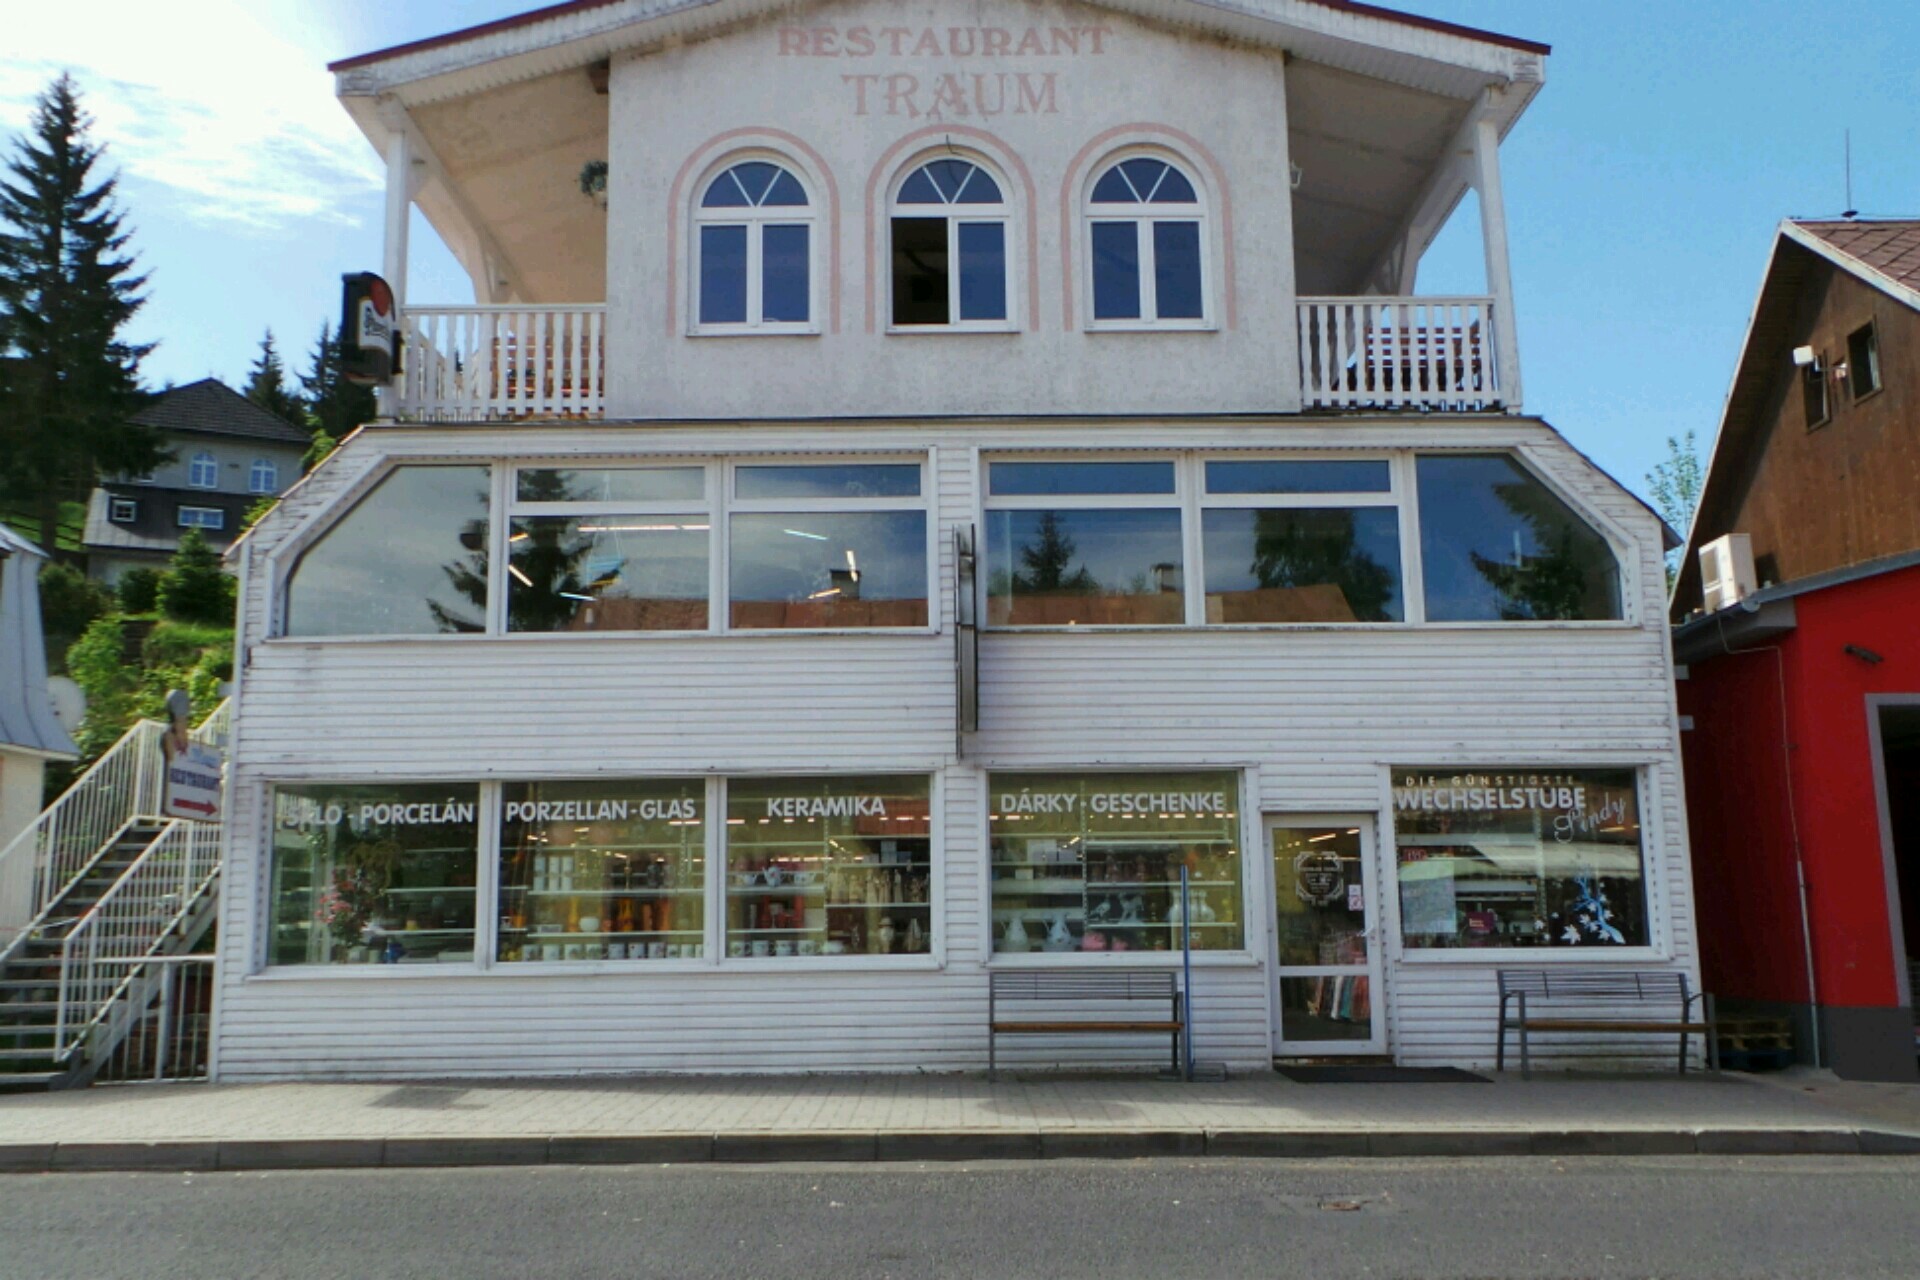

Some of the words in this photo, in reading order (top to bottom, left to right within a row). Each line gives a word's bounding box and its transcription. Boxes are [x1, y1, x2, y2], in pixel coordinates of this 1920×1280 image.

[777, 26, 1113, 57] RESTAURANT
[841, 72, 1060, 118] TRAUM
[1406, 776, 1436, 787] DIE
[360, 797, 474, 824] PORCELÁN
[766, 796, 886, 817] KERAMIKA
[1001, 788, 1077, 812] DÁRKY
[1091, 792, 1225, 813] GESCHENKE
[1396, 787, 1586, 810] WECHSELSTUBE
